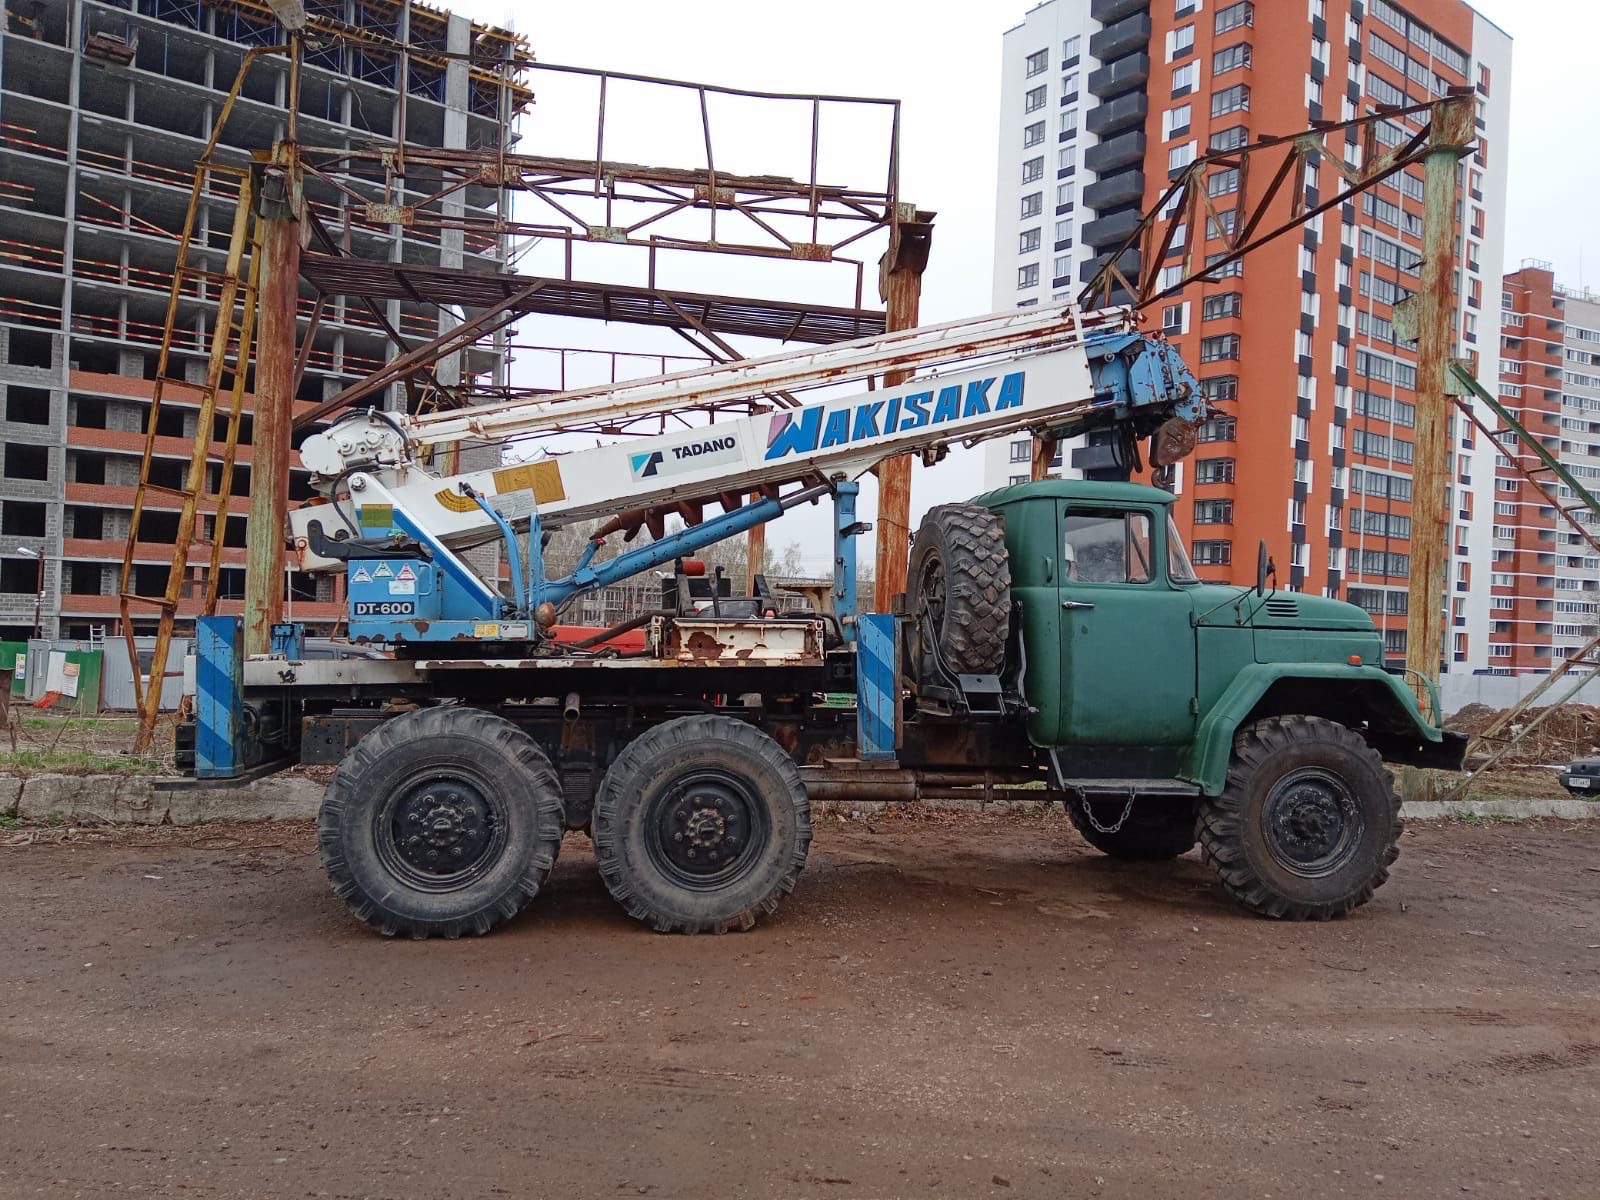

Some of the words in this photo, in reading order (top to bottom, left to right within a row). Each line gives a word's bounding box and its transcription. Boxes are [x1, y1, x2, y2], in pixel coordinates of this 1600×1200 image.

[764, 371, 1025, 461] WAKISAKA
[671, 436, 736, 460] TADANO
[356, 602, 412, 615] DT-600
